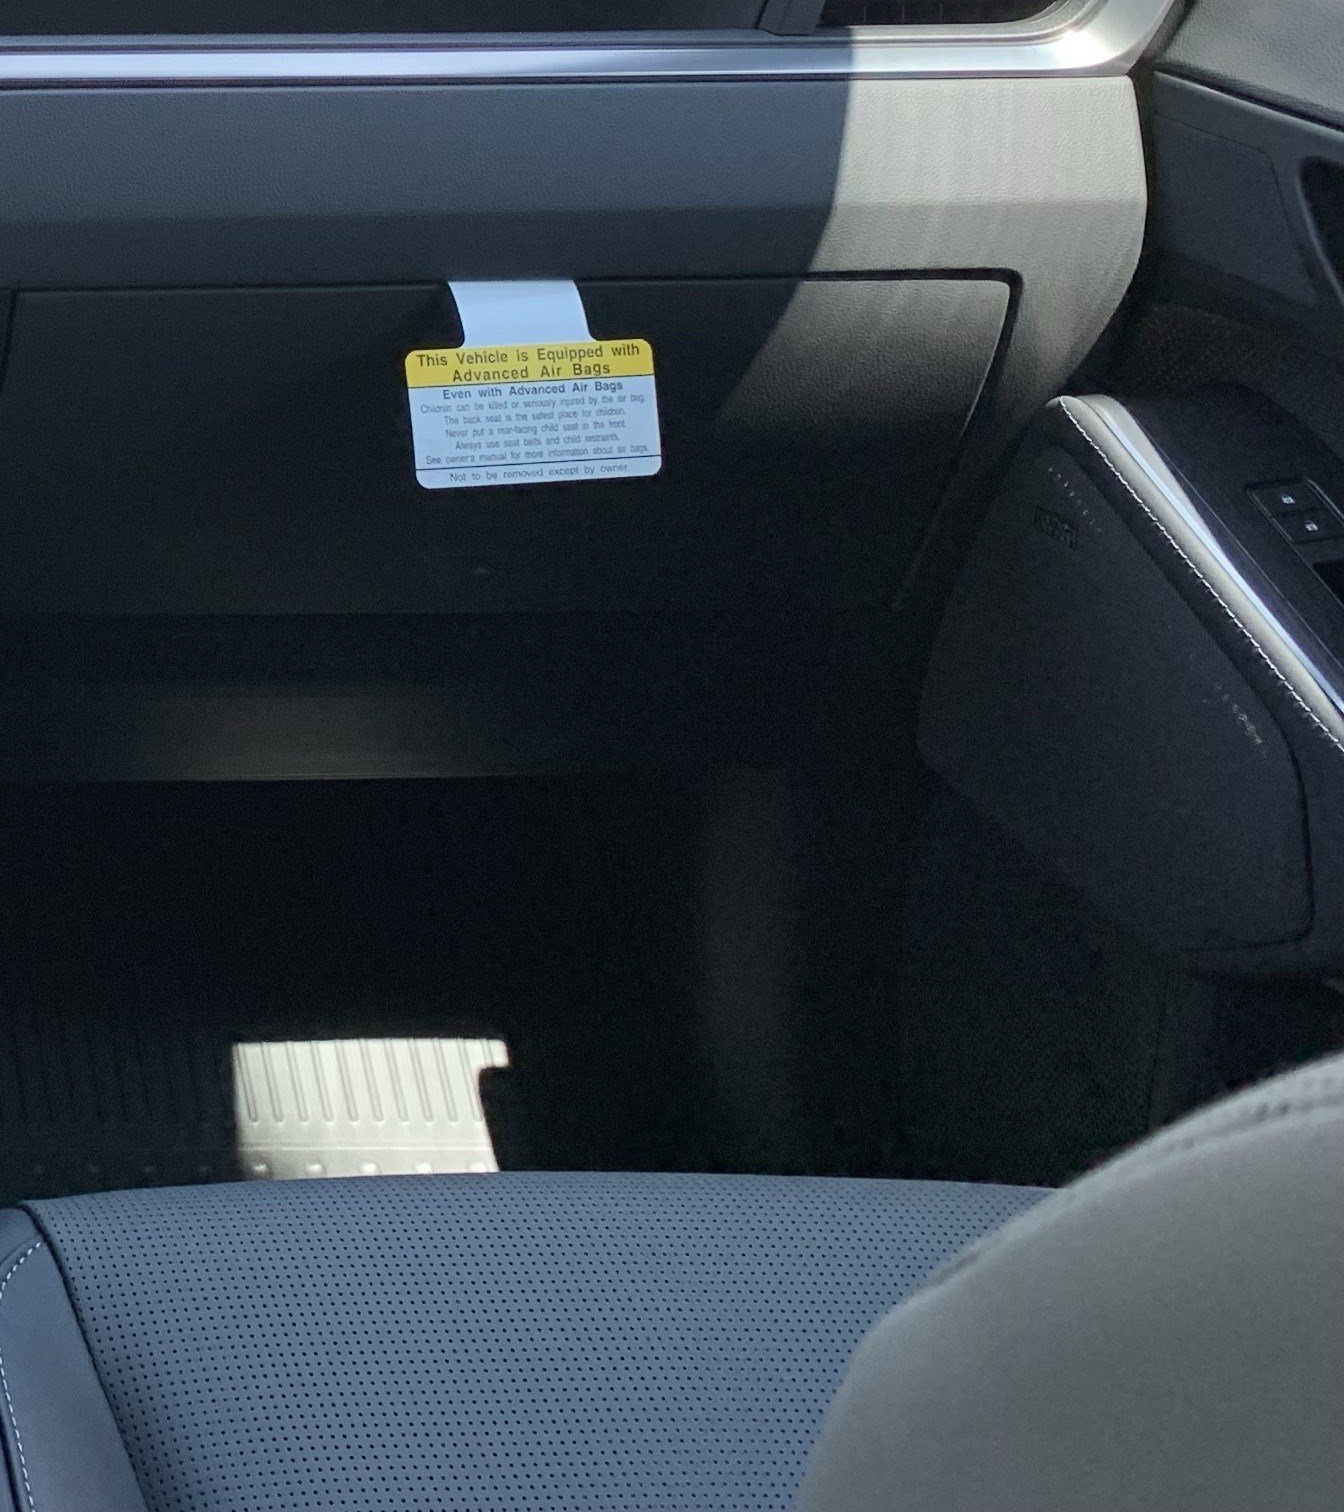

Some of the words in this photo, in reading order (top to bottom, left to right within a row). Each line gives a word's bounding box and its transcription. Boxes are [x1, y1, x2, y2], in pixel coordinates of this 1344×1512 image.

[416, 354, 448, 367] This
[456, 351, 508, 364] Vehicle
[517, 350, 528, 360] is
[537, 346, 603, 362] Equipped
[611, 343, 639, 356] with
[453, 367, 529, 382] Advanced
[541, 365, 561, 377] Air
[573, 362, 611, 376] Bags
[443, 390, 471, 399] Even
[479, 388, 502, 398] with
[509, 385, 565, 396] Advanced
[572, 383, 587, 392] Air
[595, 381, 623, 392] Bags
[421, 404, 452, 413] Children
[457, 404, 470, 412] can
[475, 403, 484, 411] be
[489, 401, 508, 410] killed
[523, 398, 556, 410] seriously
[560, 397, 584, 408] injured
[588, 397, 597, 406] by
[602, 395, 612, 403] the
[618, 394, 626, 402] air
[444, 415, 459, 425] The
[463, 414, 481, 423] back
[485, 413, 501, 422] seat
[505, 413, 511, 421] is
[515, 412, 527, 421] the
[532, 410, 554, 420] safest
[558, 410, 578, 420] place
[582, 409, 592, 417] for
[446, 428, 468, 438] Never
[473, 428, 485, 437] put
[498, 424, 537, 435] rear-facing
[541, 423, 559, 432] child
[563, 422, 578, 431] seat
[583, 421, 589, 429] in
[593, 420, 604, 429] the
[455, 440, 482, 451] Always
[486, 440, 500, 448] use
[504, 438, 519, 447] seat
[524, 437, 541, 446] belts
[546, 436, 559, 445] and
[563, 434, 581, 444] child
[426, 455, 441, 464] See
[479, 452, 506, 462] manual
[511, 451, 521, 460] for
[525, 451, 543, 459] more
[548, 447, 589, 458] information
[593, 445, 613, 455] about
[618, 445, 626, 453] air
[450, 473, 467, 482] Not
[472, 472, 481, 480] to
[485, 471, 498, 480] be
[503, 468, 543, 479] removed
[548, 466, 579, 477] except
[584, 466, 595, 475] by
